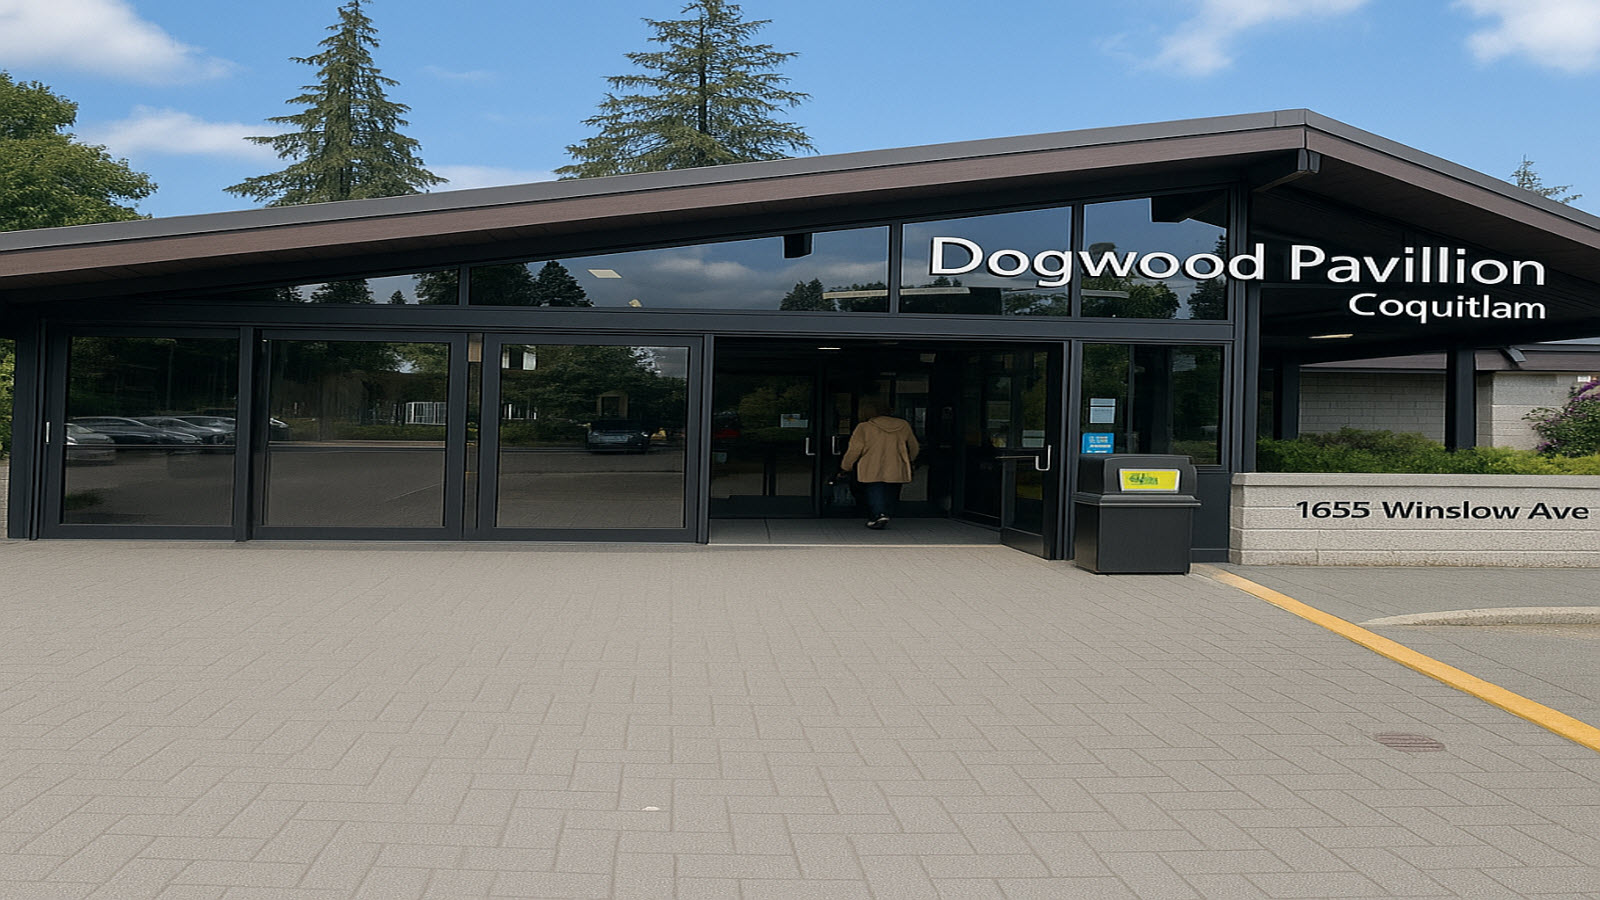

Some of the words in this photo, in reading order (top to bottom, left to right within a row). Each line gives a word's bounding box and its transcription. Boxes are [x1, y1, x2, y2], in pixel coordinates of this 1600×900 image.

[931, 236, 1265, 286] Dogwood
[1290, 245, 1546, 285] Pavillion
[1349, 292, 1547, 324] Coquitlam
[1297, 501, 1370, 519] 1655
[1382, 500, 1520, 519] Winslow
[1527, 502, 1590, 520] Ave
